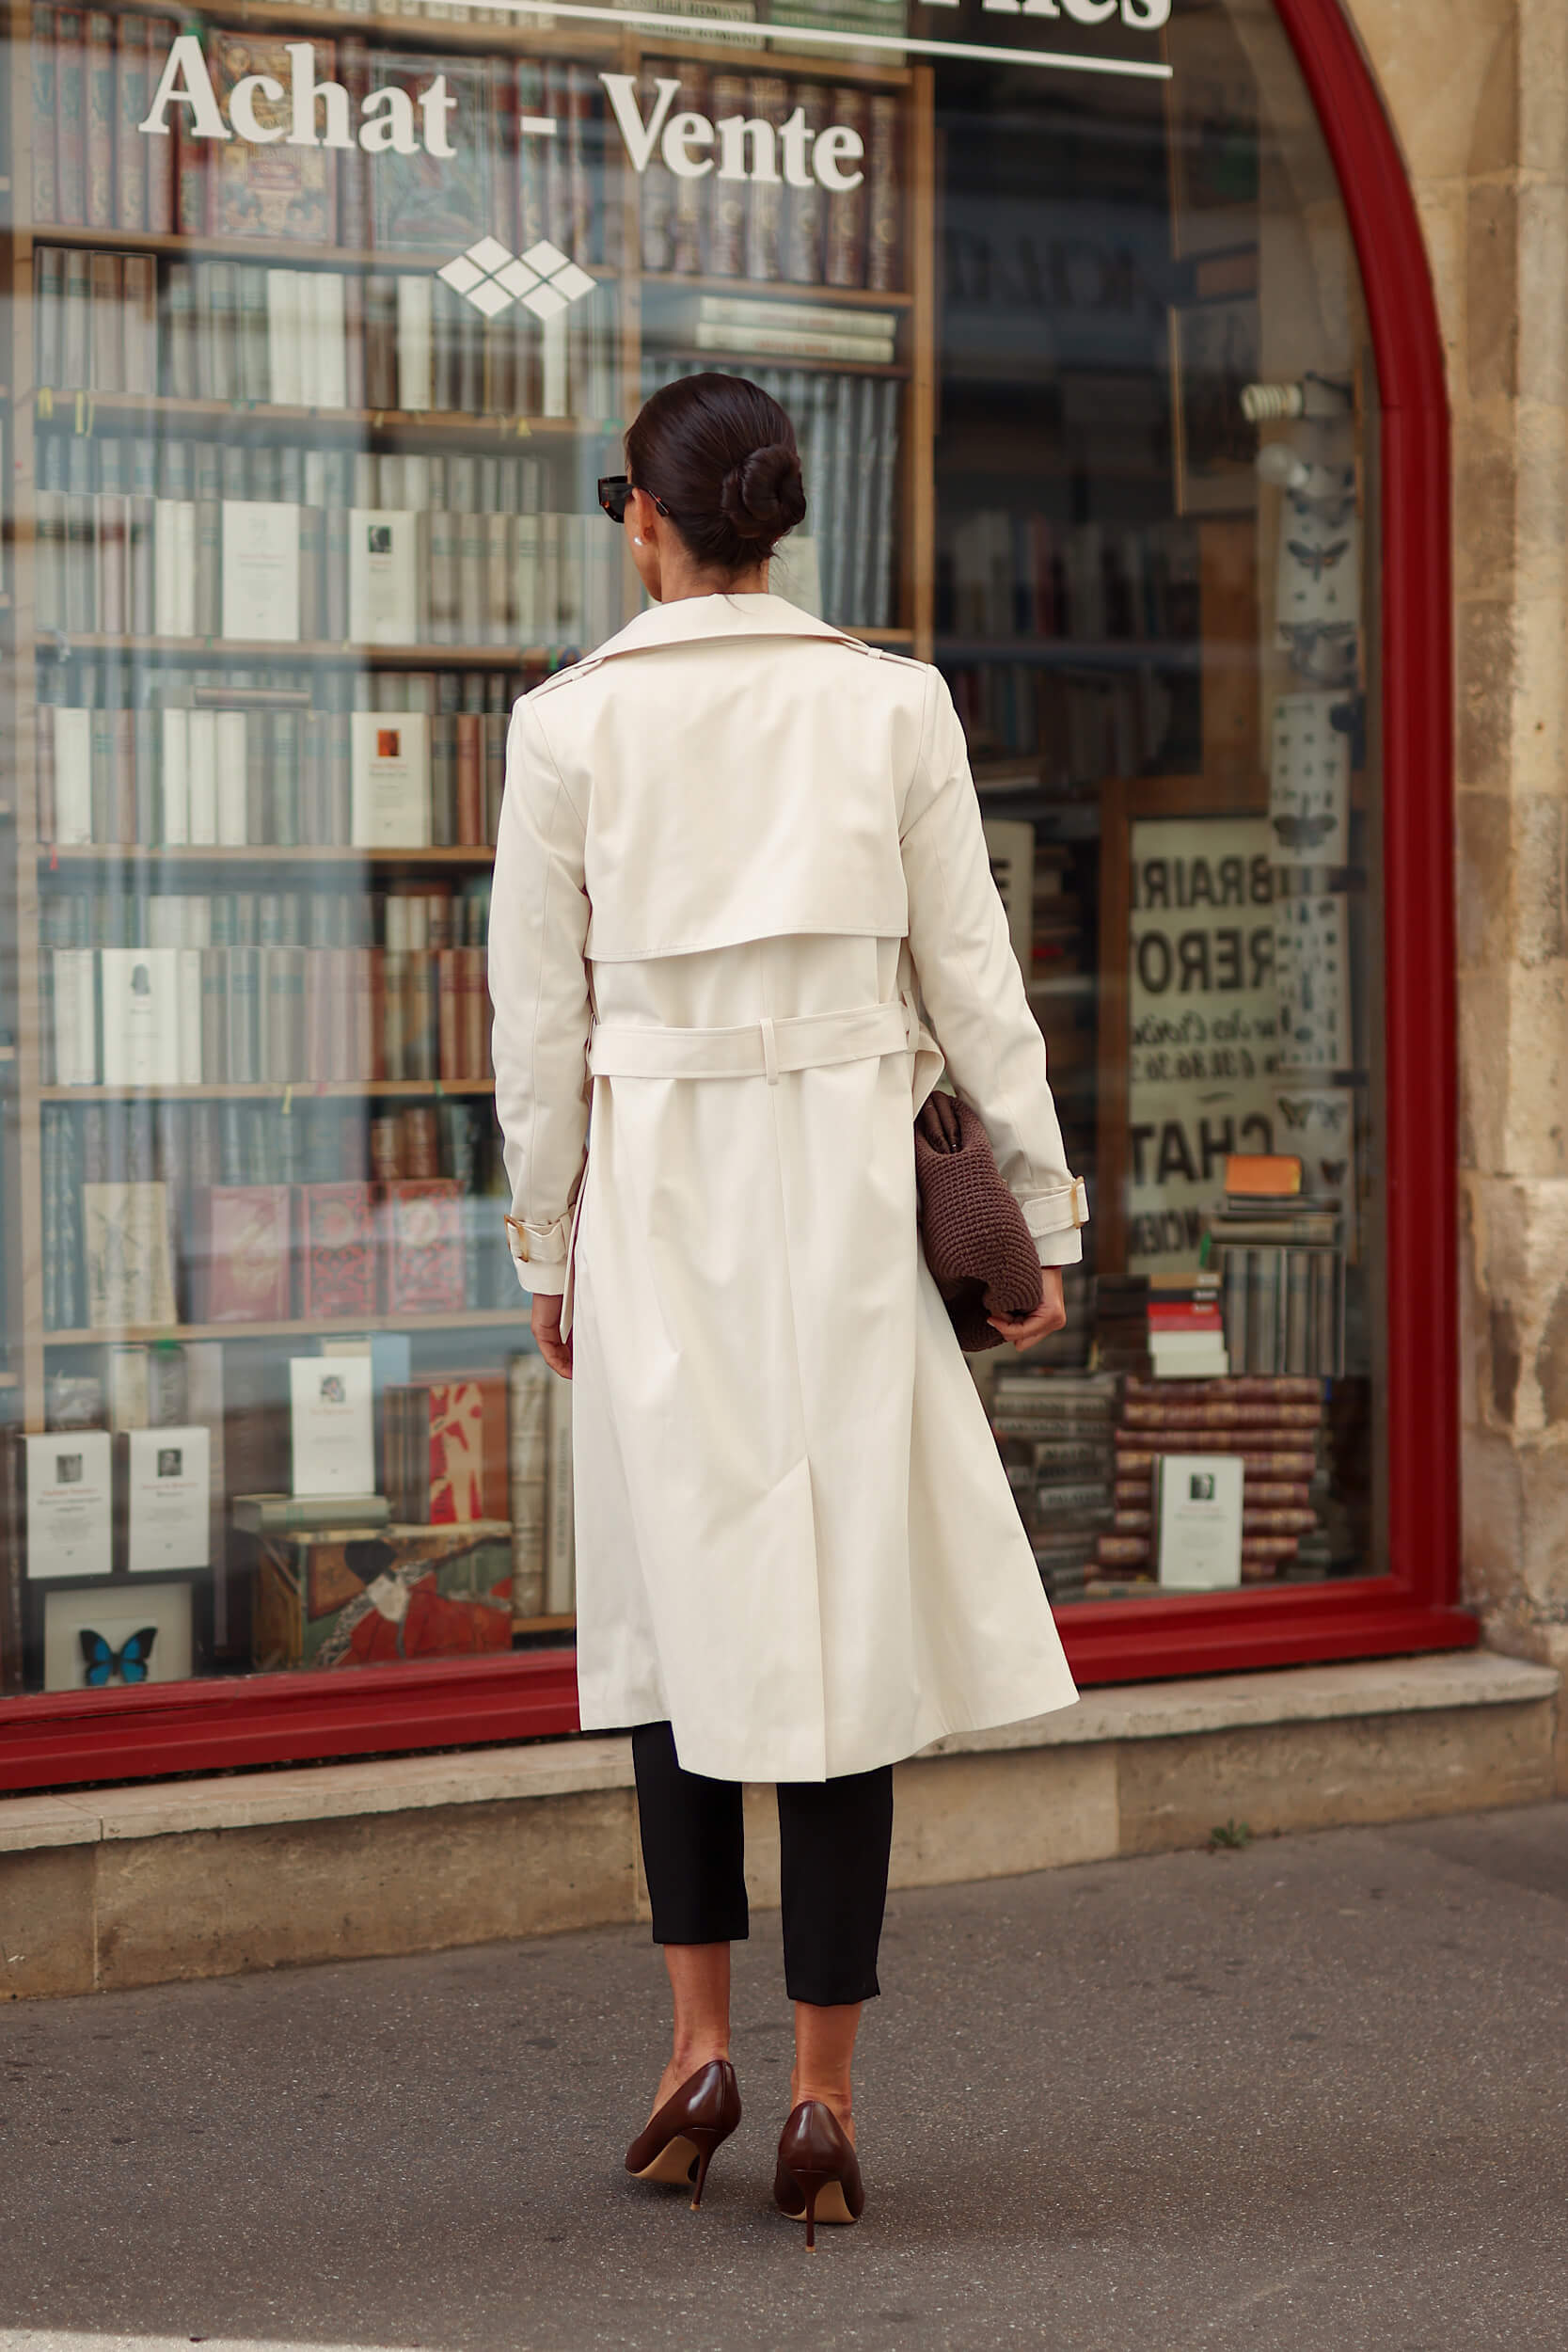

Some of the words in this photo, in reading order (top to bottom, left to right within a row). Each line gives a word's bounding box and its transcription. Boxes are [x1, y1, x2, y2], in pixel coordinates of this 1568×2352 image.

[138, 35, 457, 157] Achat
[519, 115, 557, 135] -
[598, 72, 864, 191] Vente
